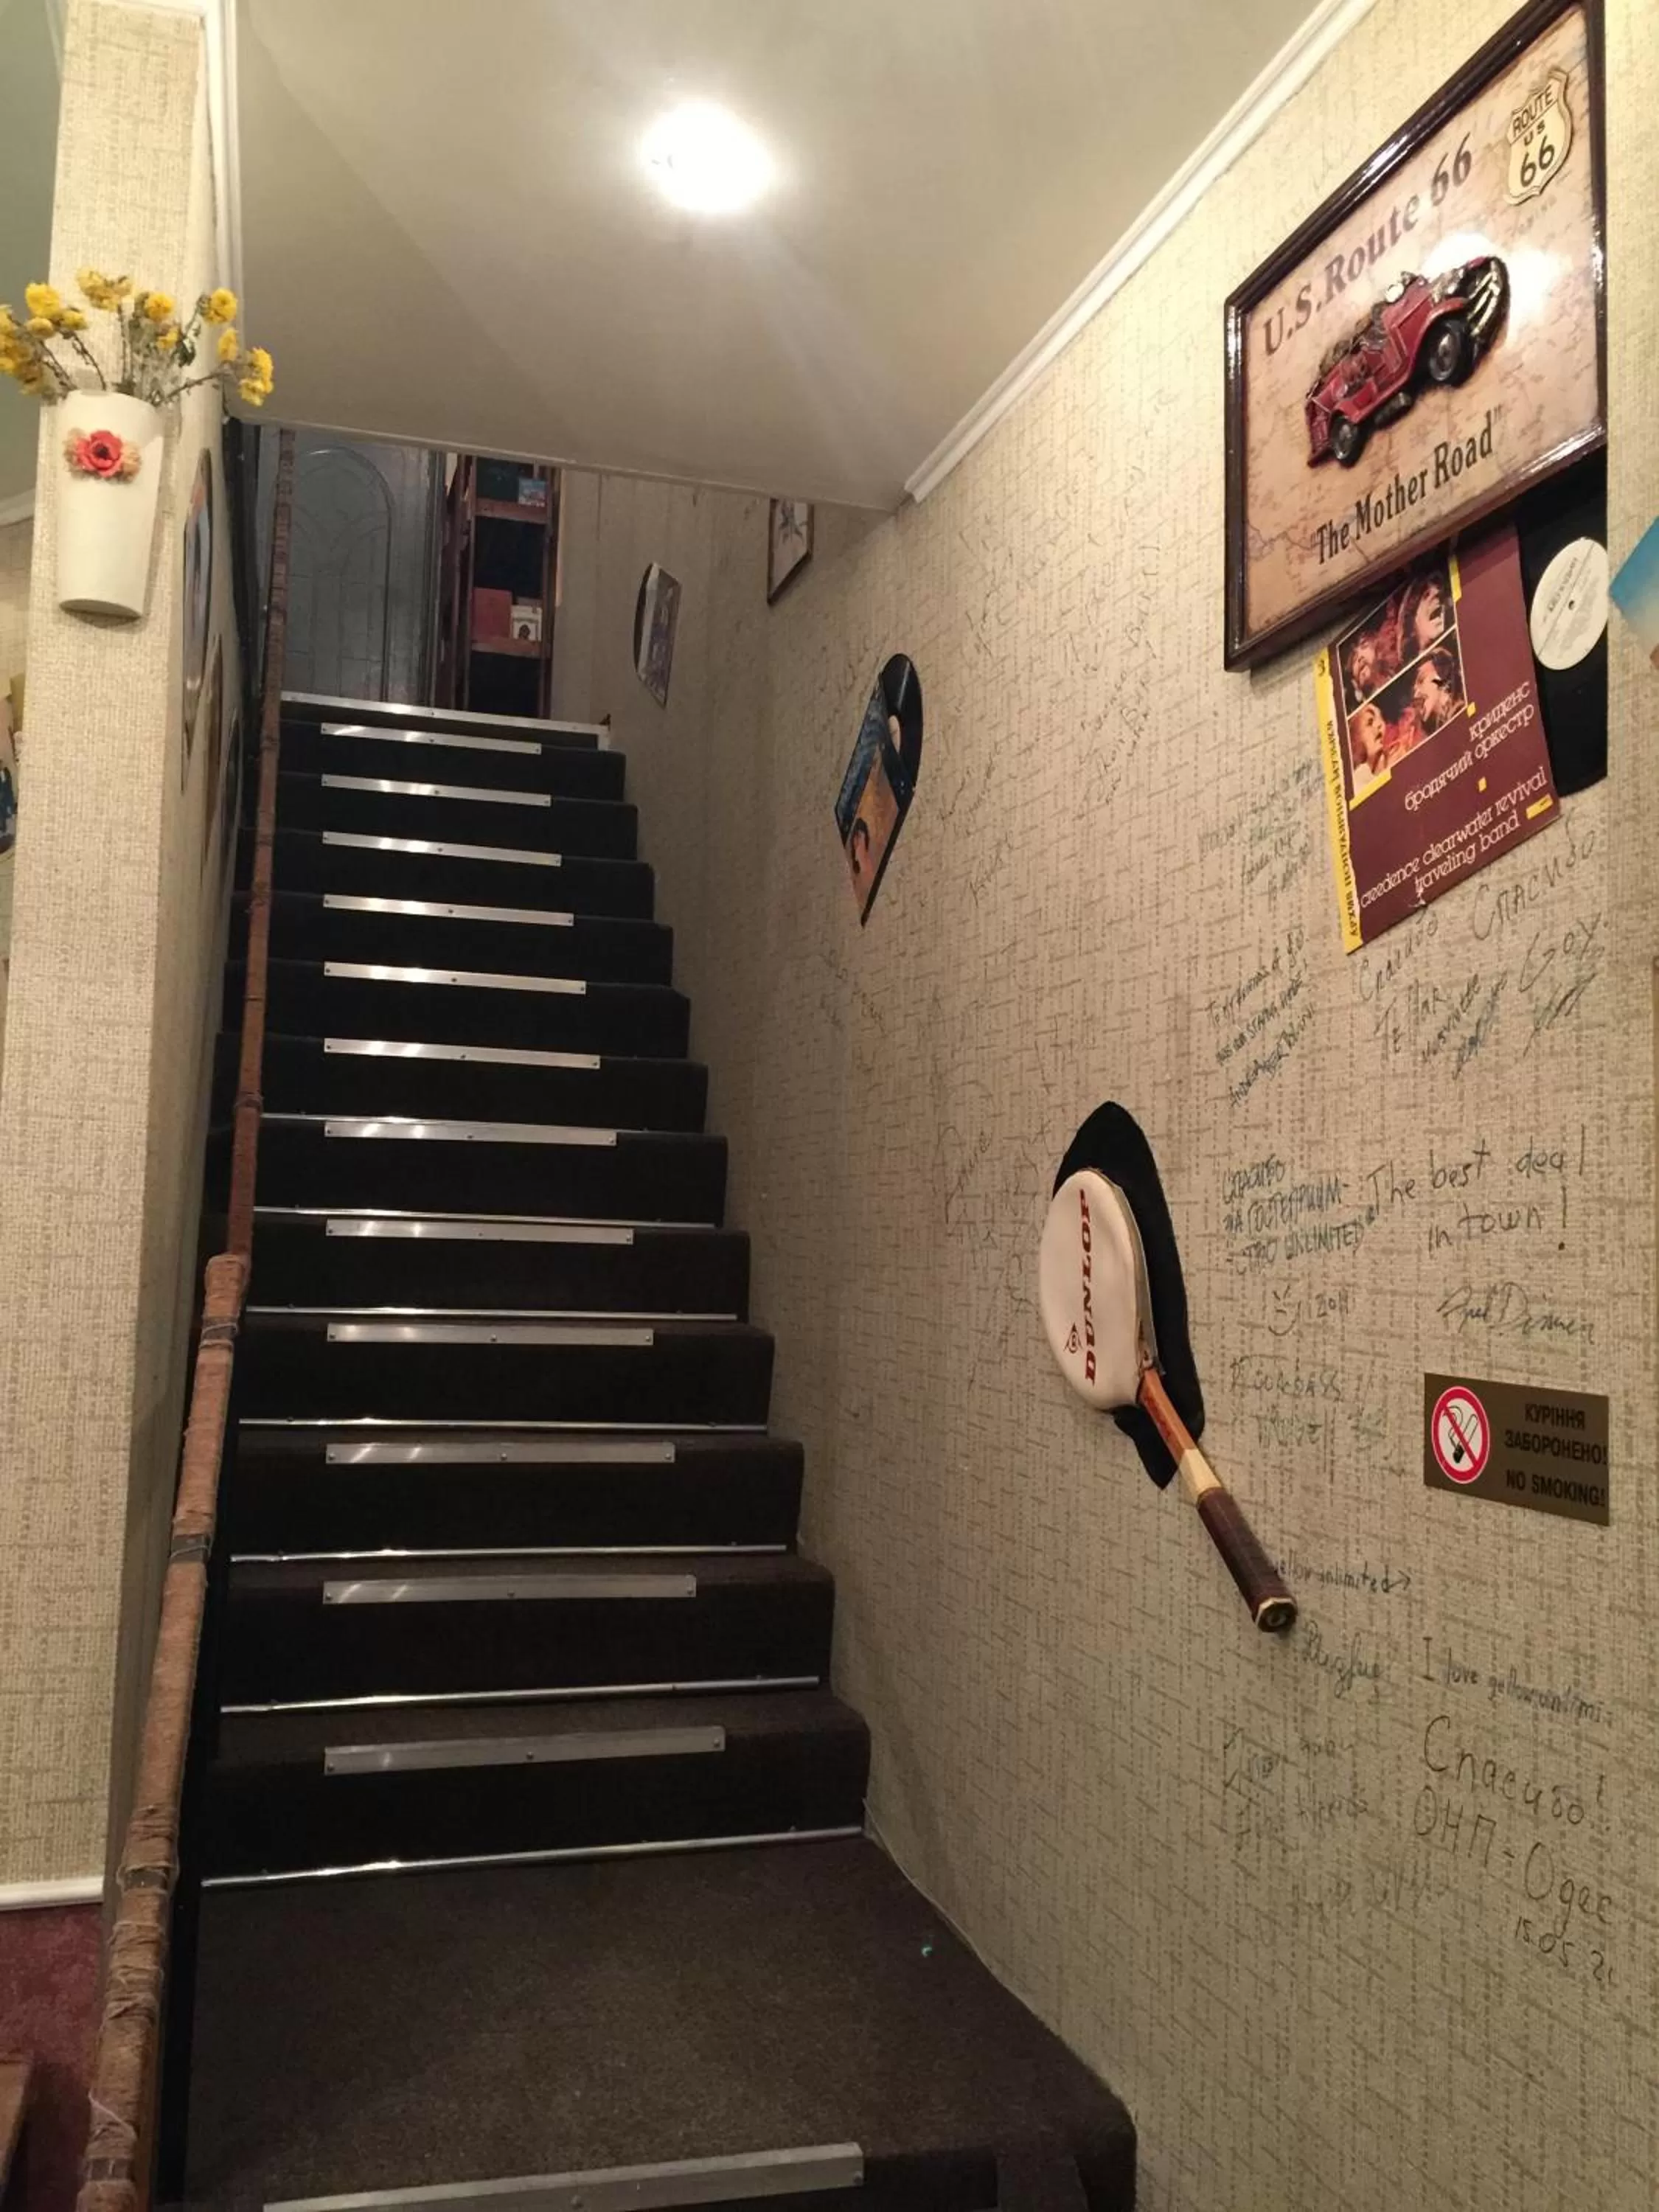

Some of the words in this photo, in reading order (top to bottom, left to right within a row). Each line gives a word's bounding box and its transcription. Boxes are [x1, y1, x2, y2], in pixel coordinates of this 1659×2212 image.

[1512, 84, 1554, 139] ROUTE
[1524, 119, 1545, 147] US
[1520, 135, 1555, 187] 66
[1324, 193, 1421, 306] Route
[1430, 131, 1472, 206] 66
[1354, 468, 1427, 540] Mother
[1405, 750, 1473, 812] бродячий
[1475, 704, 1535, 759] оркестр
[1360, 856, 1421, 908] creedence
[1422, 807, 1493, 866] clearwater
[1495, 767, 1548, 817] revival
[1415, 843, 1476, 889] traveling
[1479, 809, 1521, 853] band
[1367, 1160, 1416, 1215] The
[1430, 1138, 1491, 1189] best
[1516, 1124, 1585, 1180] deal
[1079, 1188, 1096, 1387] DUNLOP
[1504, 1430, 1608, 1465] ЗАБОРОНЕНО!
[1524, 1403, 1586, 1430] КУРІННЯ
[1506, 1469, 1526, 1491] NO
[1531, 1474, 1606, 1508] SMOKING!
[1422, 1635, 1435, 1682] I
